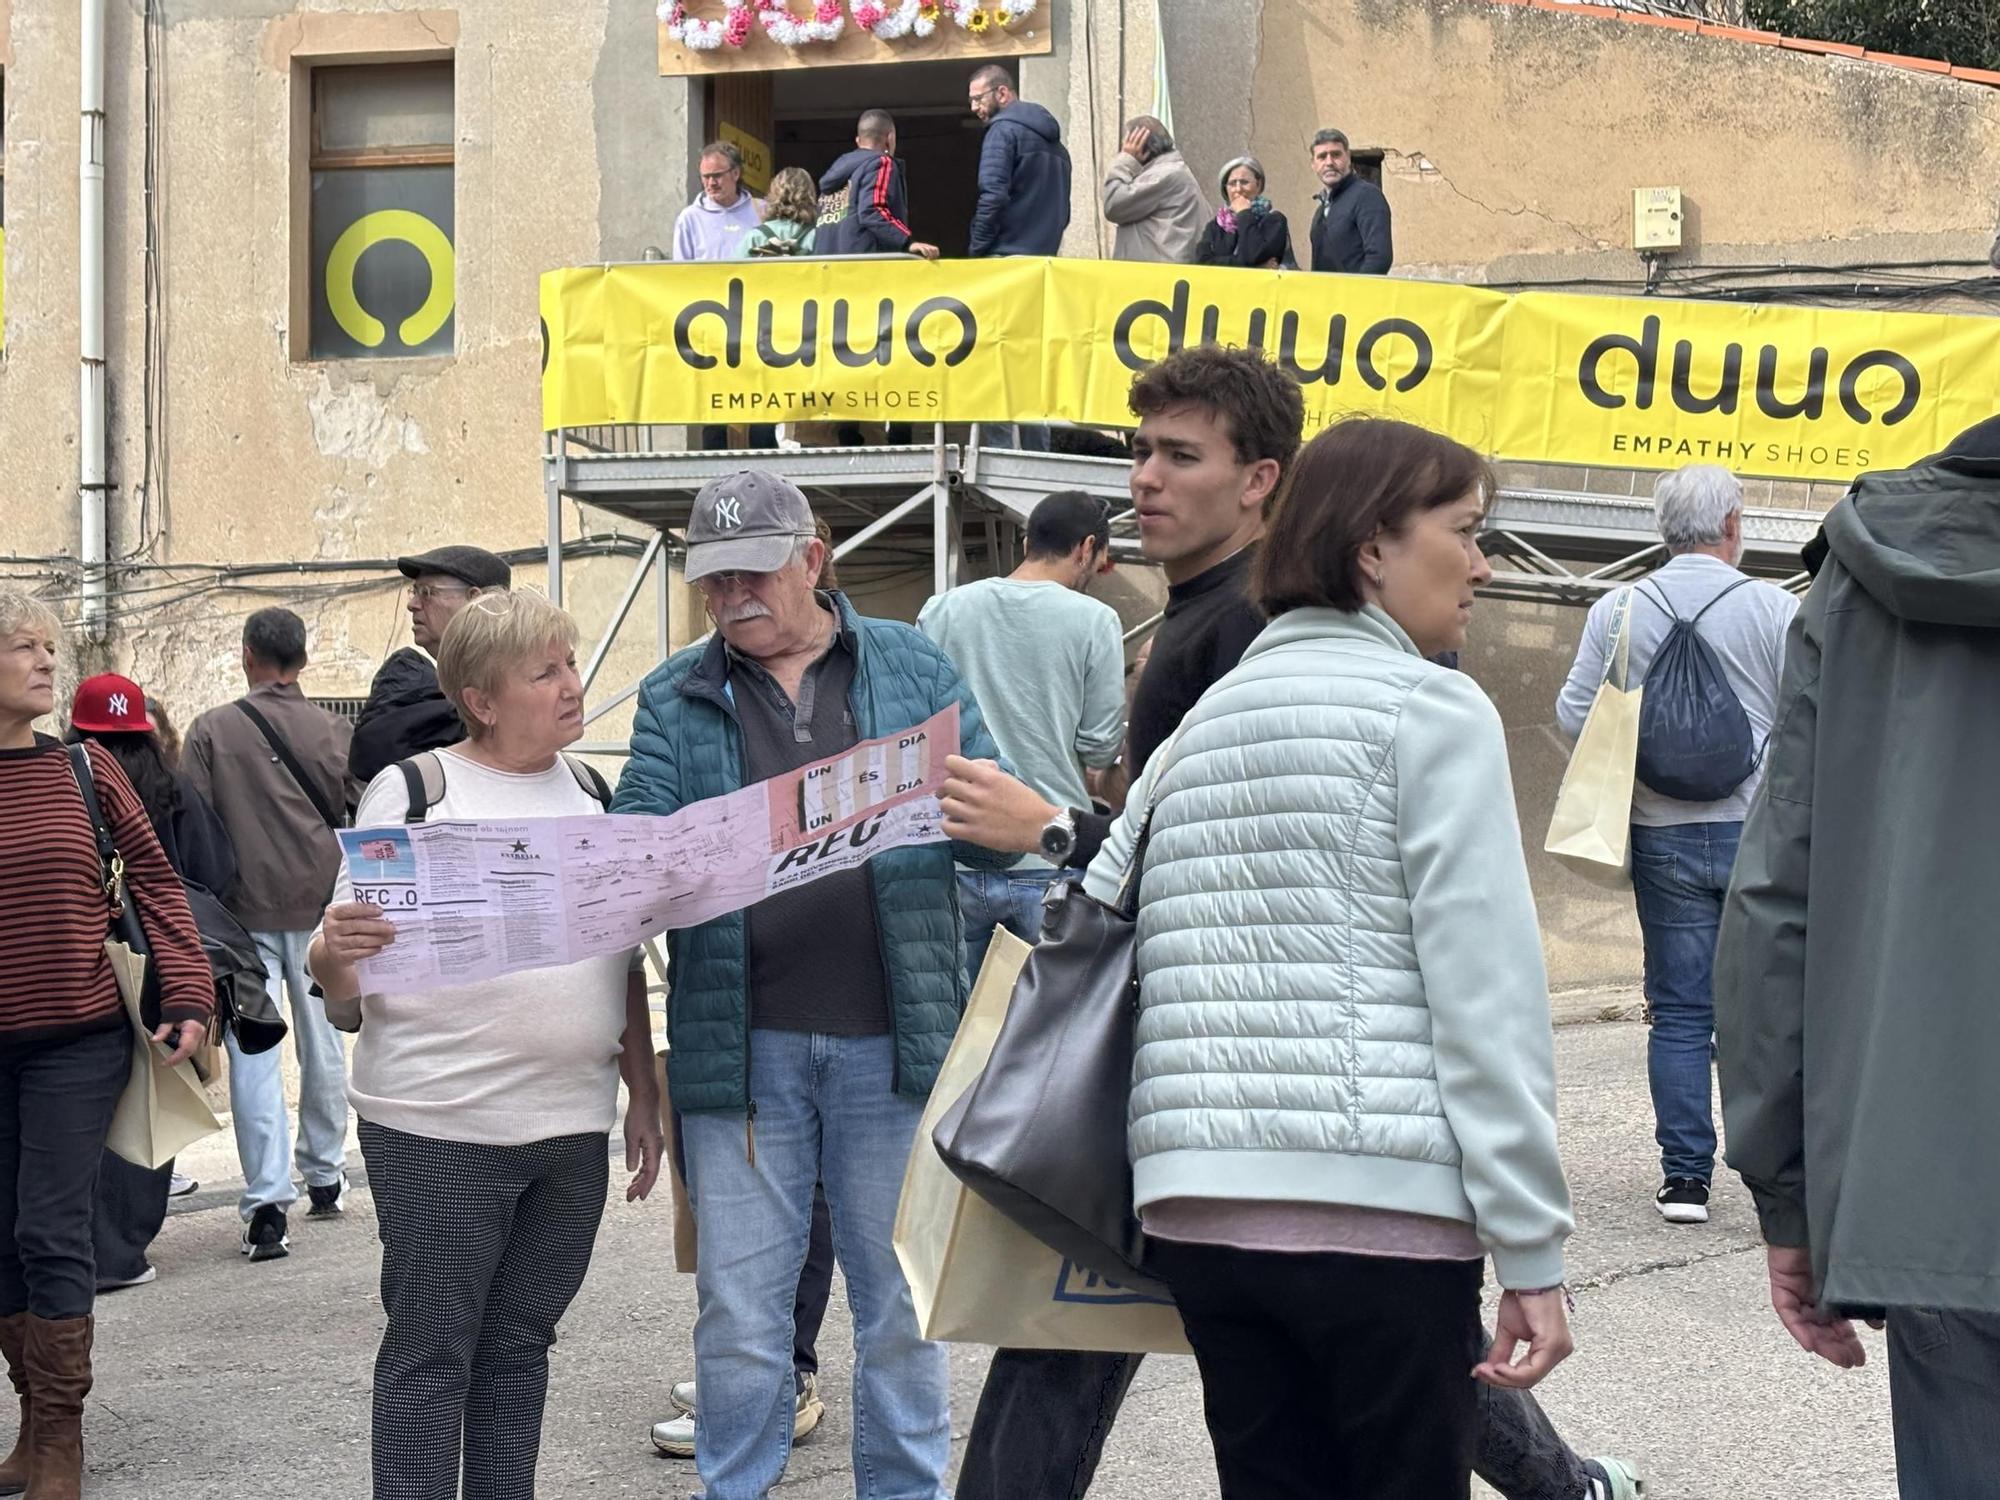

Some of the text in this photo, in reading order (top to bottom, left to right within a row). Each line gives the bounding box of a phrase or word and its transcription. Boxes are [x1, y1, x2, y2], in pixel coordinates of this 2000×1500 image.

[673, 278, 977, 369] duuo
[1579, 315, 1921, 427] duuo
[711, 390, 939, 409] EMPATHY SHOES
[1613, 434, 1871, 467] EMPATHY SHOES
[899, 732, 926, 749] DIA
[808, 765, 831, 779] UN
[859, 770, 879, 784] ÉS
[896, 778, 923, 793] DIA
[809, 813, 832, 829] UN
[353, 887, 390, 905] REC
